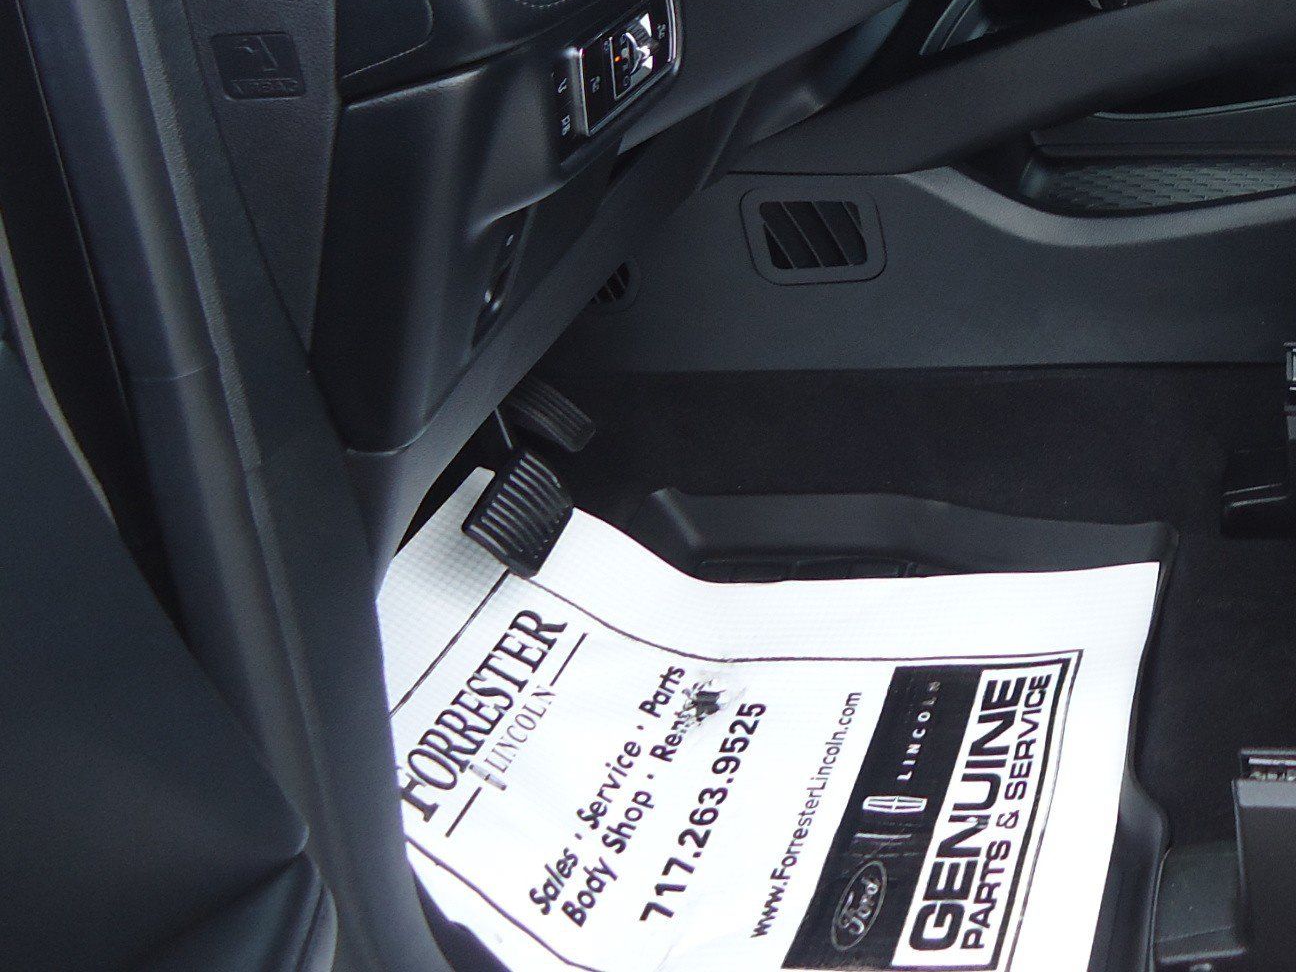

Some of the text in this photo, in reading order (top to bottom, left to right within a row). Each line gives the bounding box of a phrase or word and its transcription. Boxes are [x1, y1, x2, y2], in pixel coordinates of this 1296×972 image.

[398, 609, 568, 823] FORRESTER
[484, 685, 556, 774] LINCOLN
[529, 665, 686, 916] Sales Service Parts
[639, 702, 767, 922] 717.263.9525
[750, 691, 862, 938] www.ForresterLincoln.com
[897, 681, 941, 782] LINCOLN
[908, 676, 1028, 951] GENUINE
[960, 673, 1053, 950] PARTS & SERVICE
[561, 856, 618, 928] Body
[601, 790, 655, 855] Shop
[838, 876, 879, 935] Ford
